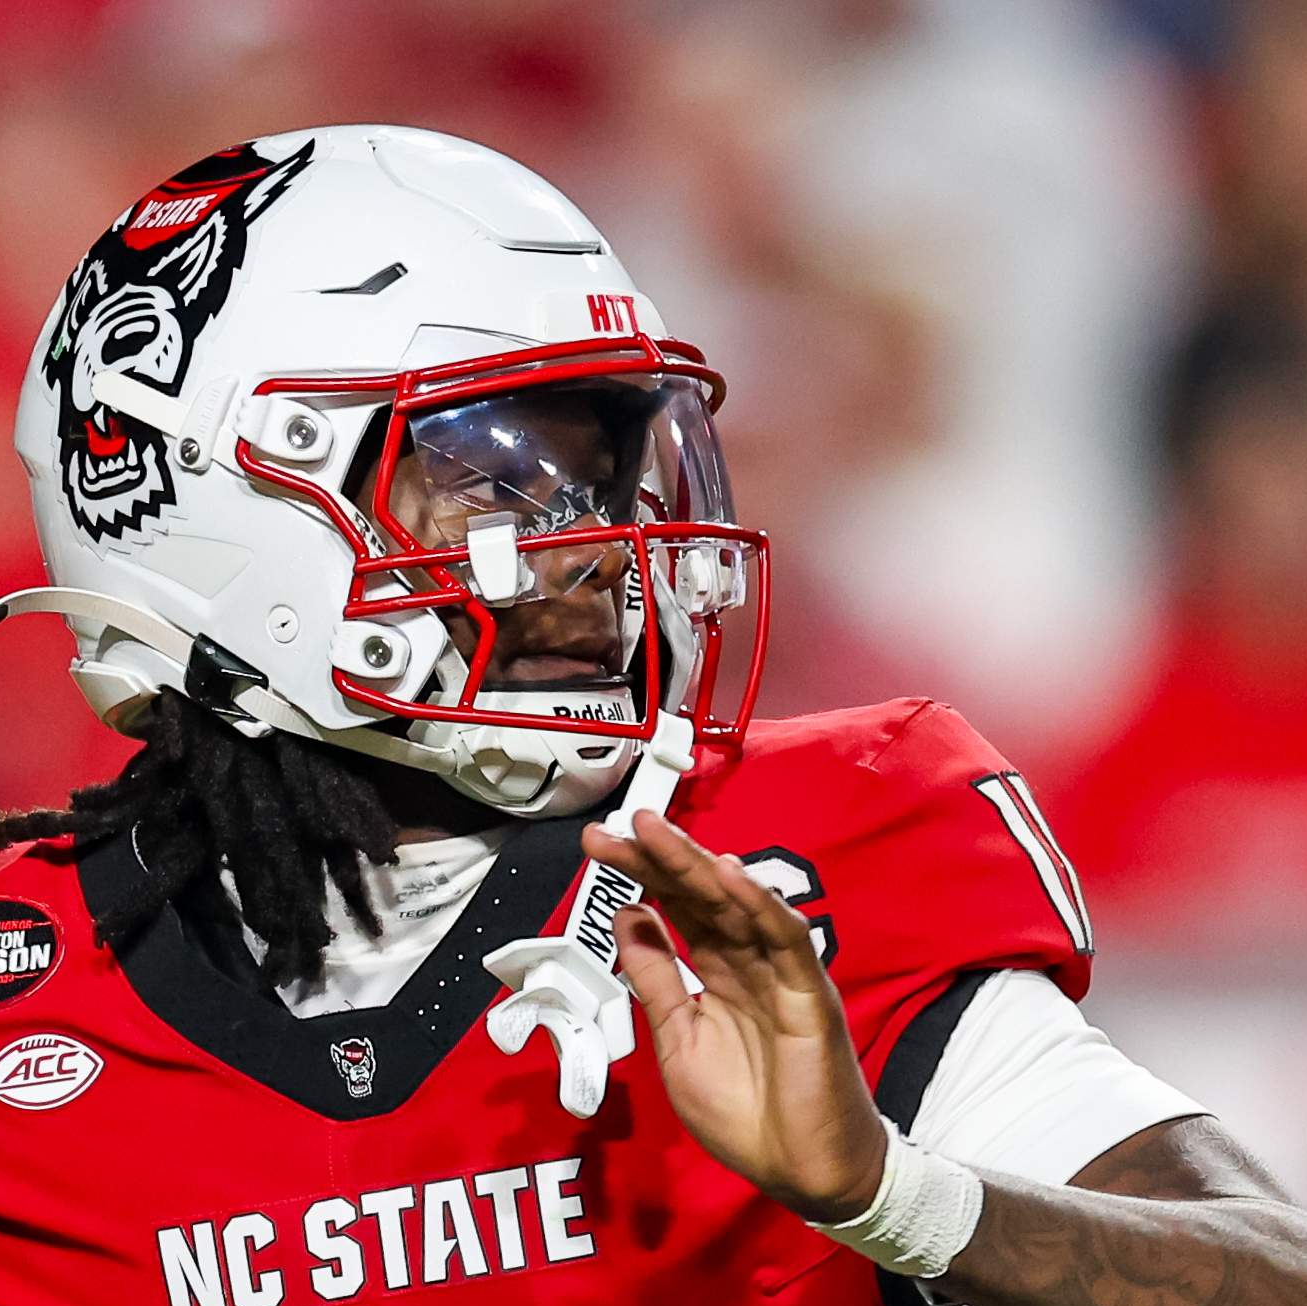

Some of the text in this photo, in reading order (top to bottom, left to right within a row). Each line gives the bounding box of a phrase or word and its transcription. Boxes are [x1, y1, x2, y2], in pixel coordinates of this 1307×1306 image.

[585, 294, 639, 333] HTT
[1, 1051, 80, 1084] ACC
[302, 1156, 596, 1301] STATE
